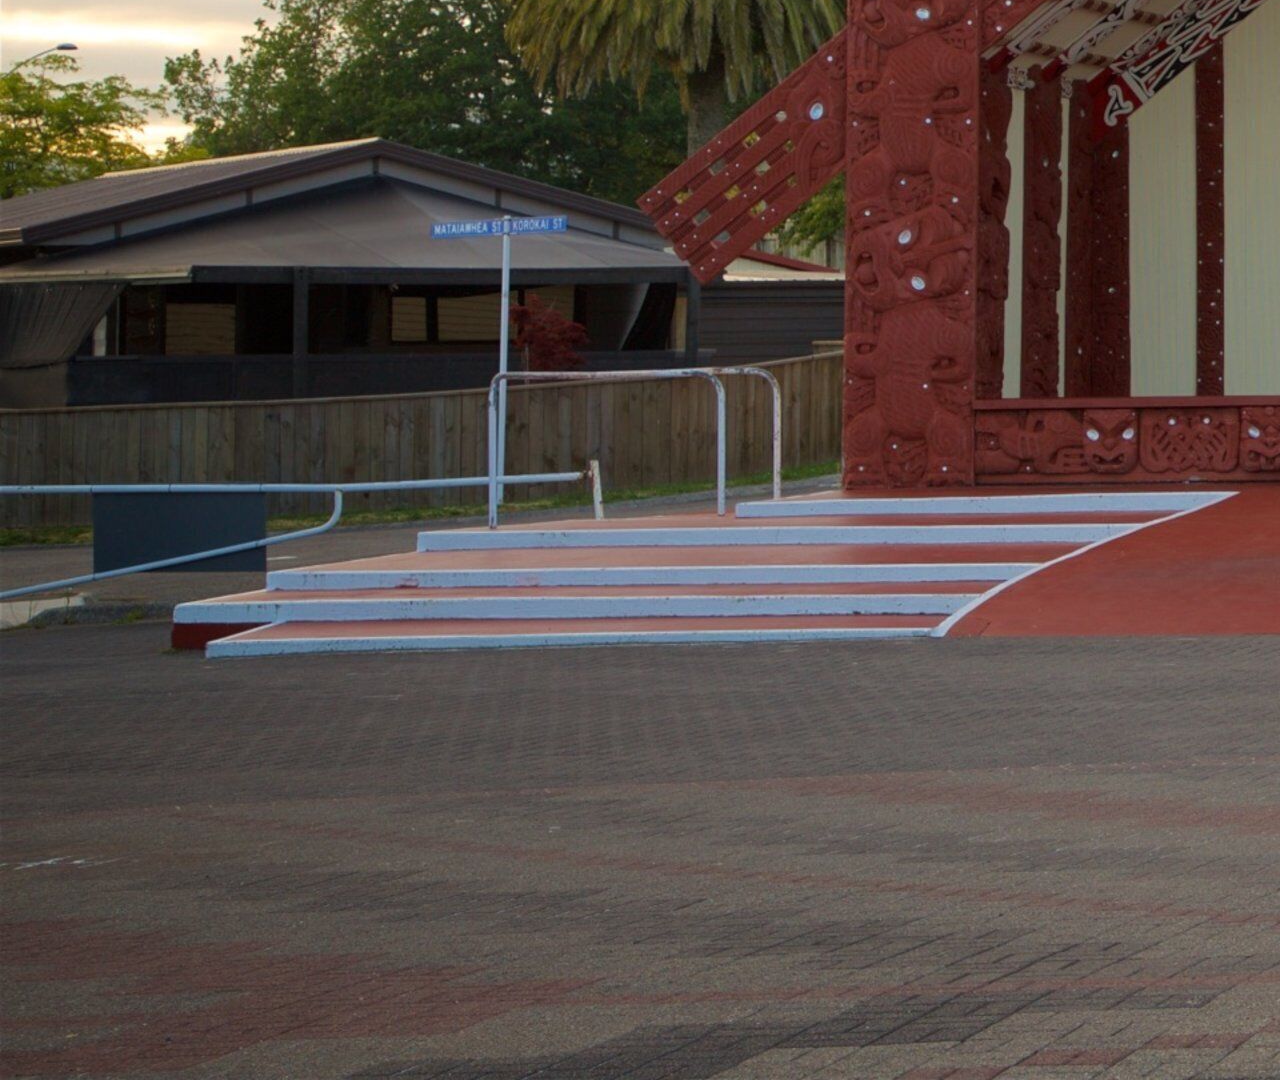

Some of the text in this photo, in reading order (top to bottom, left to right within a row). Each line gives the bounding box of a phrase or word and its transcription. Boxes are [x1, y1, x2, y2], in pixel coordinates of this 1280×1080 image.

[491, 221, 502, 232] ST
[512, 218, 563, 231] KOROKAI ST
